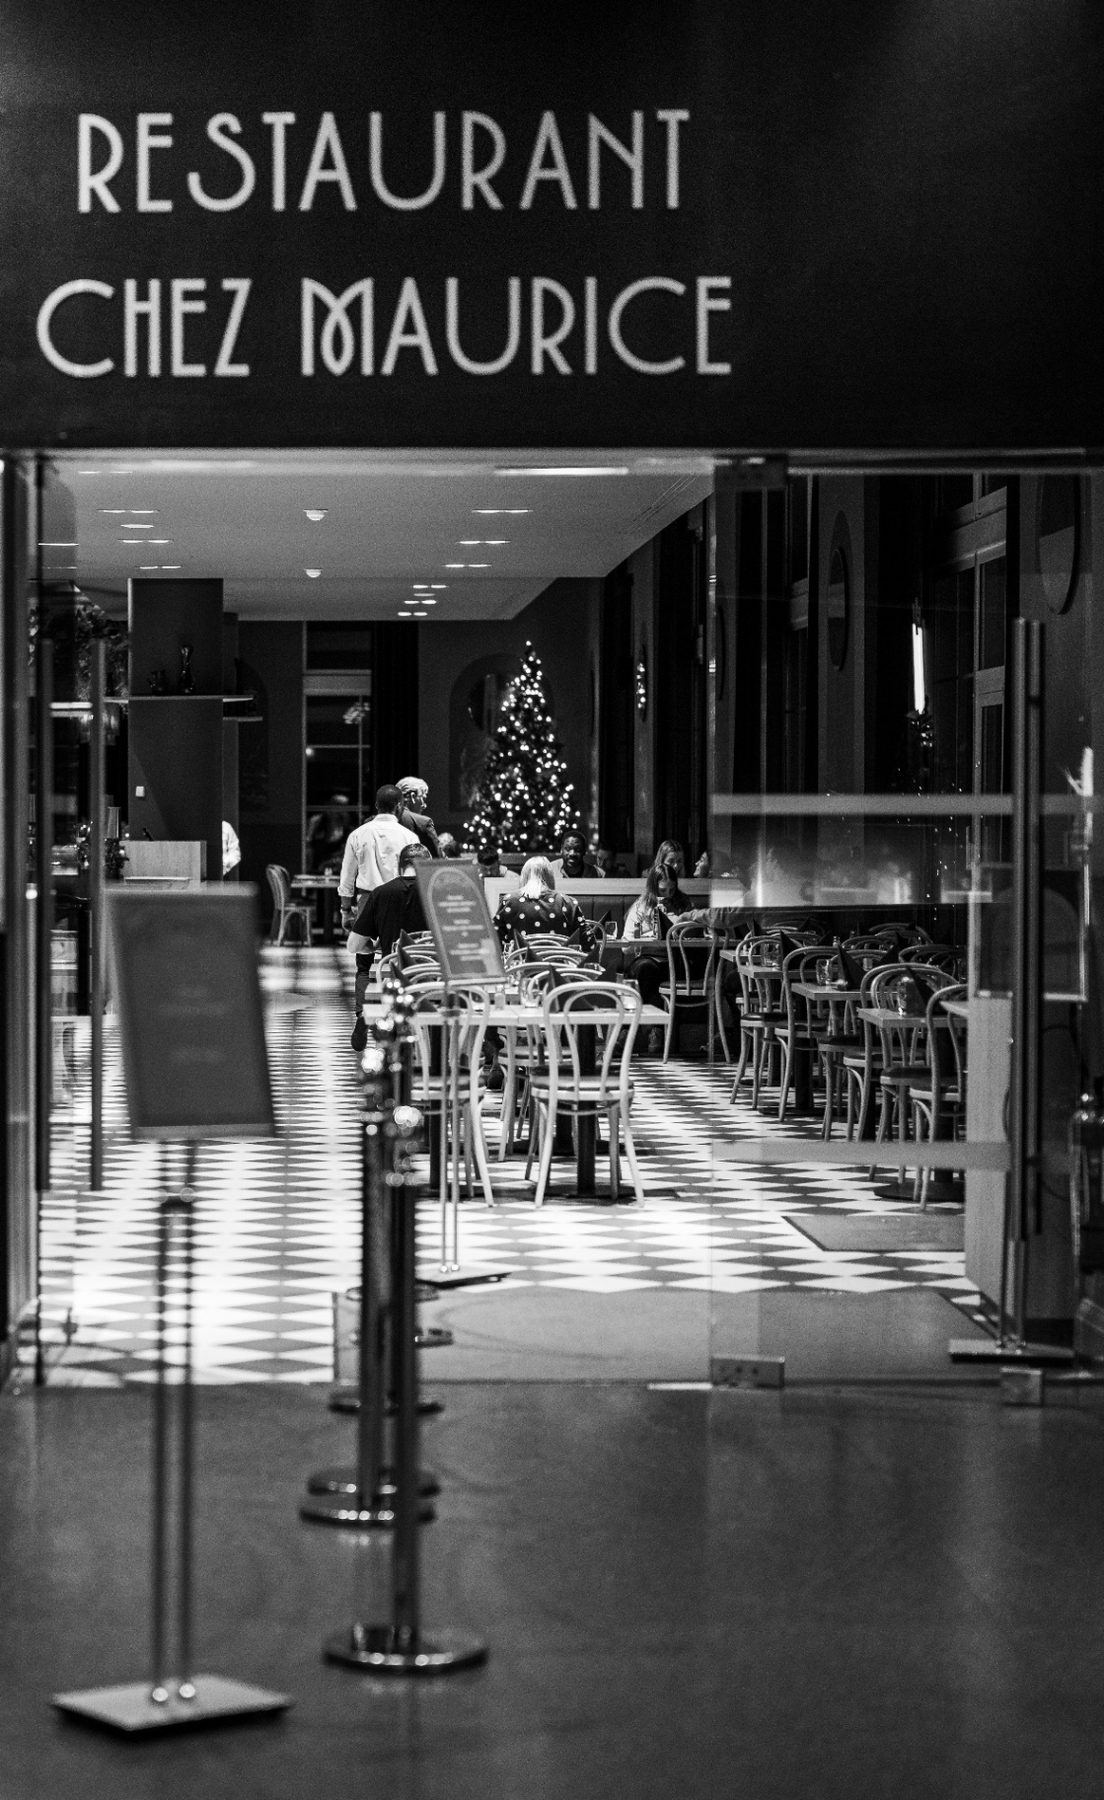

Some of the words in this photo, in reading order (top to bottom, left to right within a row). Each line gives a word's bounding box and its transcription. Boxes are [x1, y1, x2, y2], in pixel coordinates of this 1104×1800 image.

[76, 109, 690, 214] RESTAURANT
[36, 278, 252, 378] CHEZ
[300, 275, 732, 377] MAURICE
